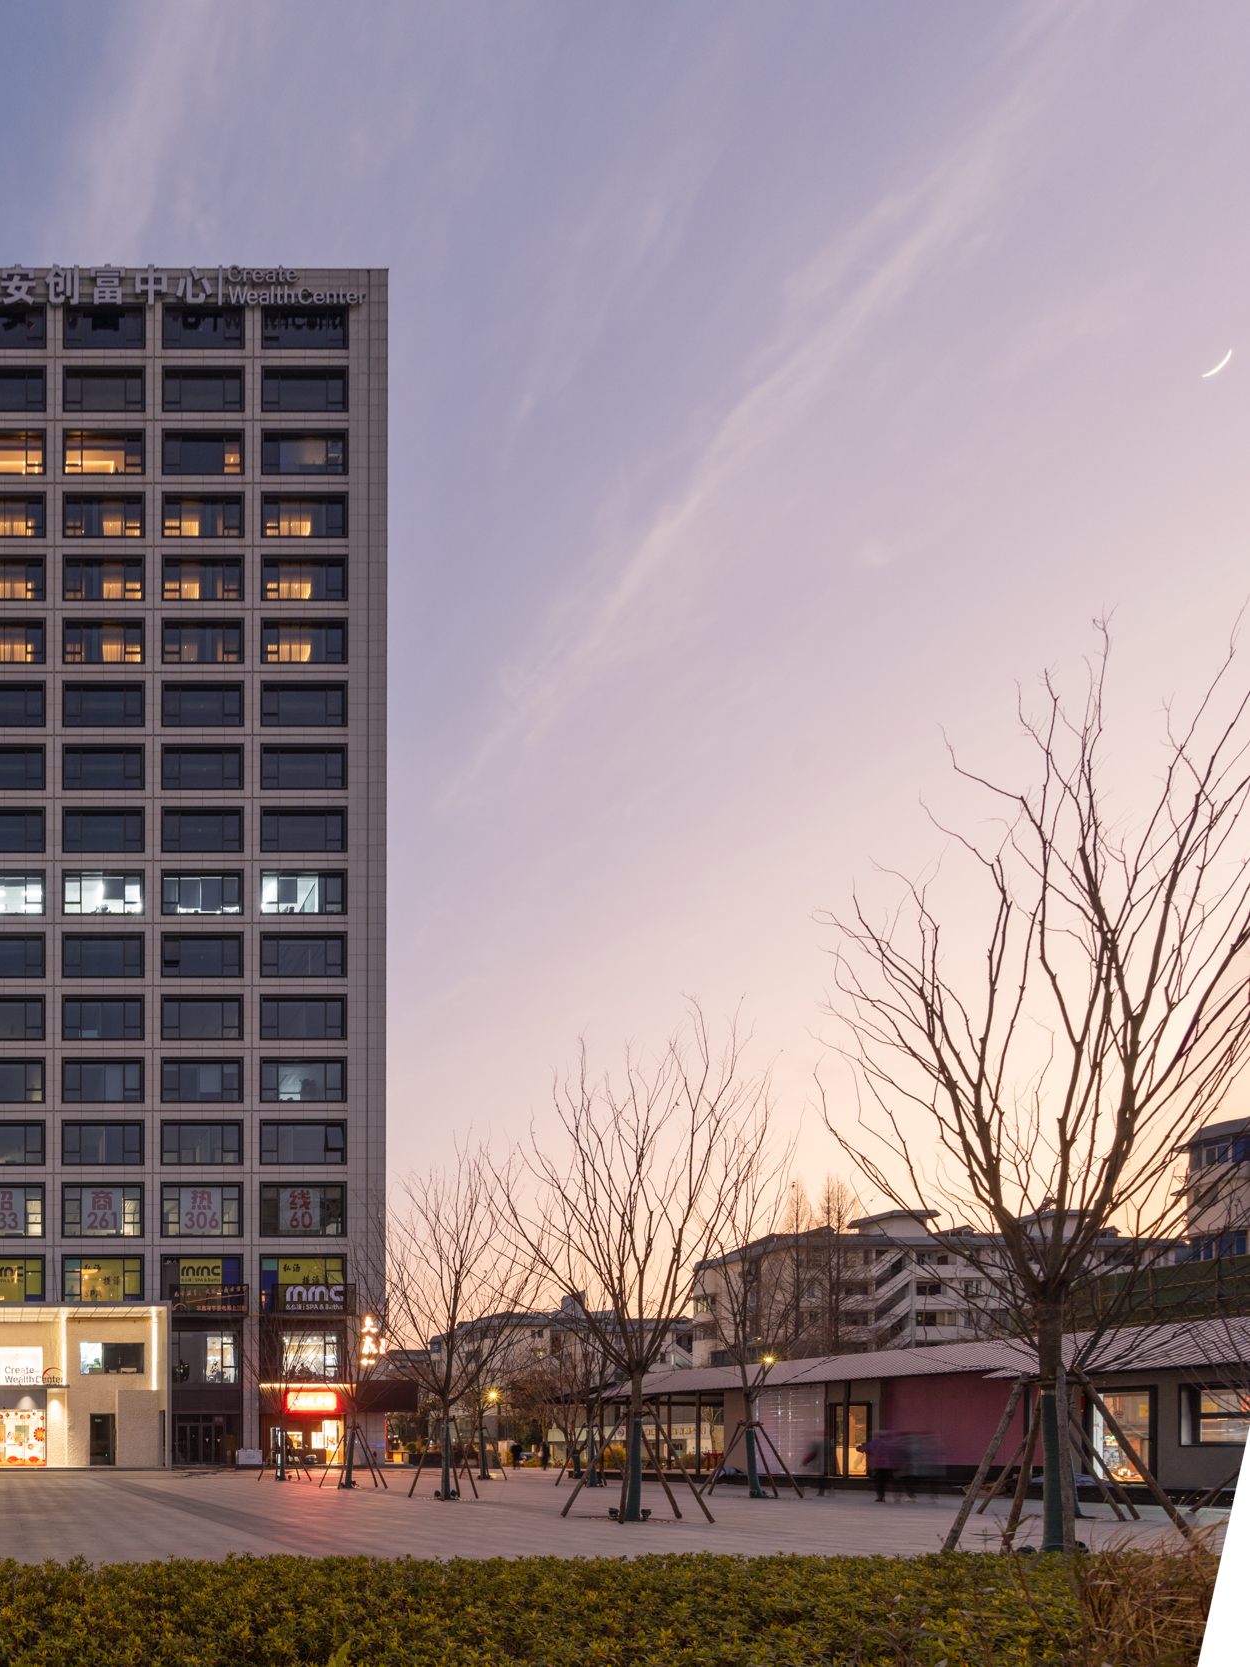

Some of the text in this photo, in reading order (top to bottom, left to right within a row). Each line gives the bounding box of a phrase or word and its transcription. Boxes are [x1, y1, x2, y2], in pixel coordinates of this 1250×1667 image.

[227, 265, 298, 283] Create
[228, 286, 366, 305] Wealth Center
[91, 1190, 113, 1211] 商
[190, 1189, 213, 1211] 热
[289, 1189, 311, 1211] 线
[87, 1211, 118, 1230] 261
[184, 1211, 220, 1230] 306
[289, 1211, 313, 1230] 60
[181, 1265, 221, 1277] mmc
[285, 1285, 344, 1302] mmc
[4, 1366, 35, 1374] Create
[4, 1376, 35, 1384] Wealth
